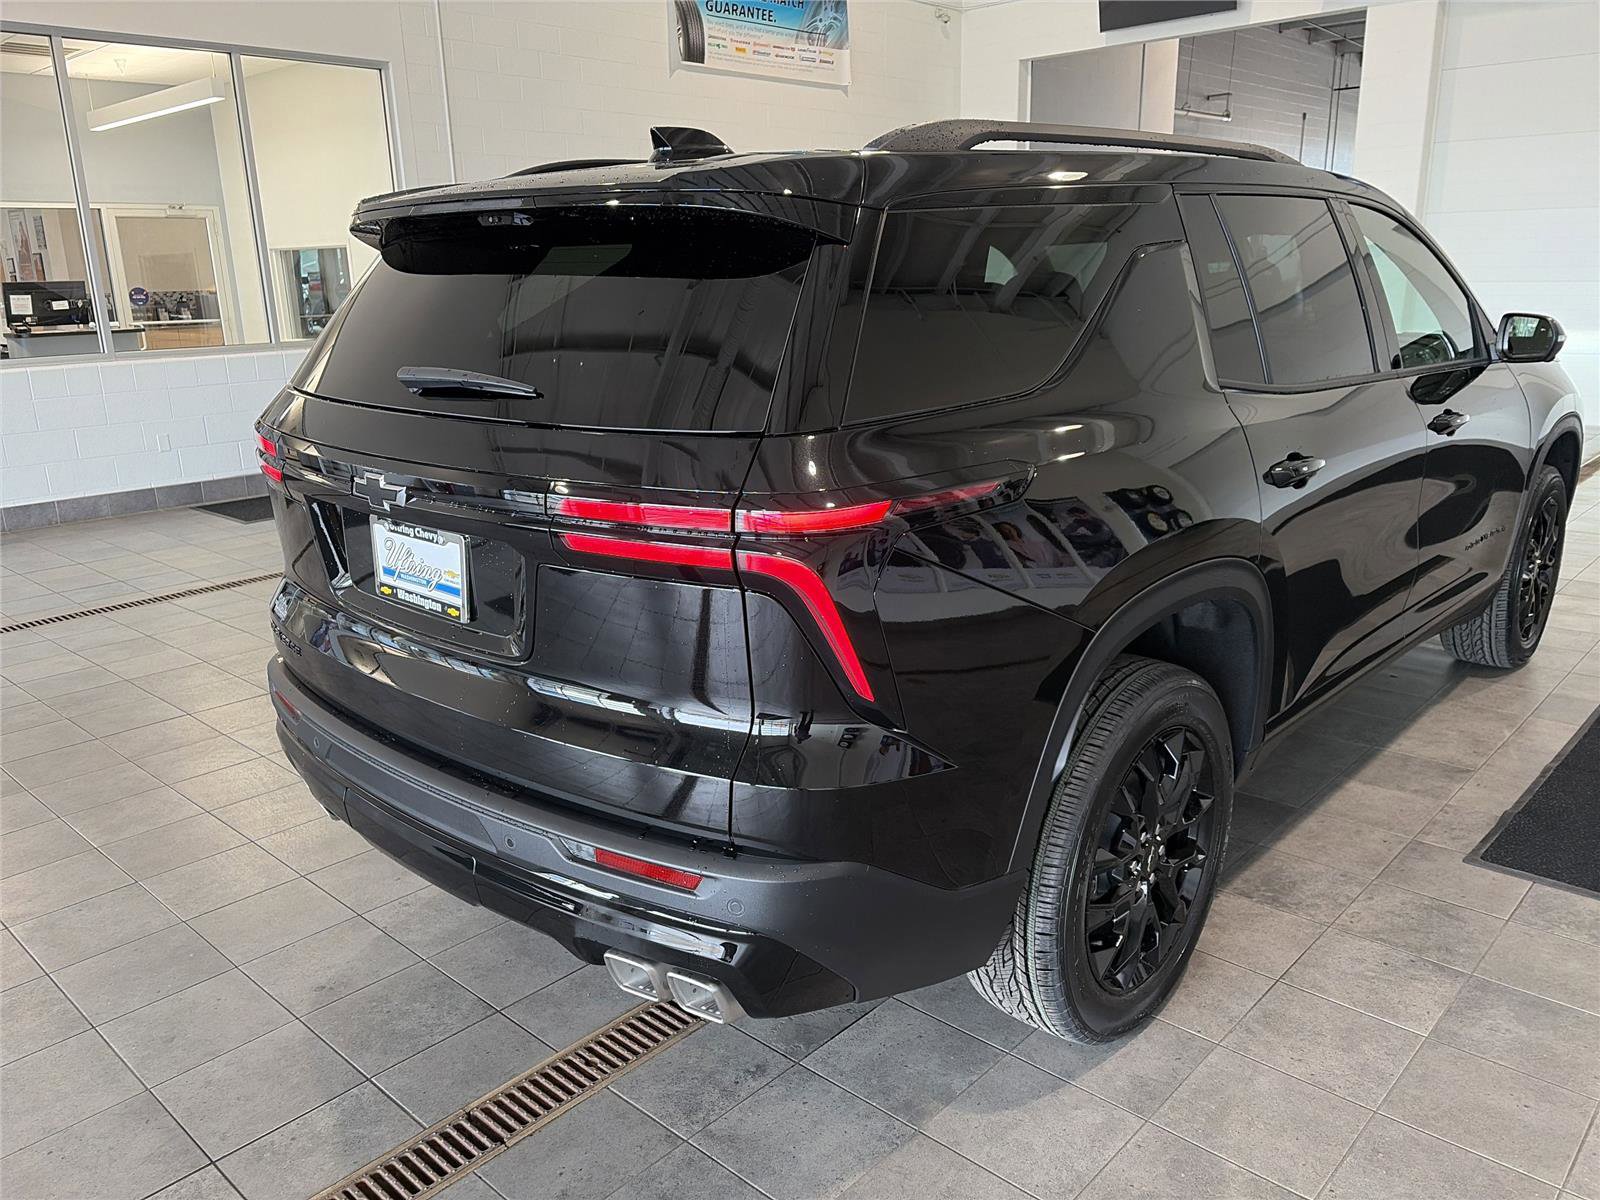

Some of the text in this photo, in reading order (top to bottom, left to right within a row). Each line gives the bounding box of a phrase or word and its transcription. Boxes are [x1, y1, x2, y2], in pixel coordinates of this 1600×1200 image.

[705, 0, 777, 23] GUARANTEE.
[415, 527, 438, 543] Chevy
[384, 537, 444, 592] Uftring
[397, 588, 442, 612] Washington
